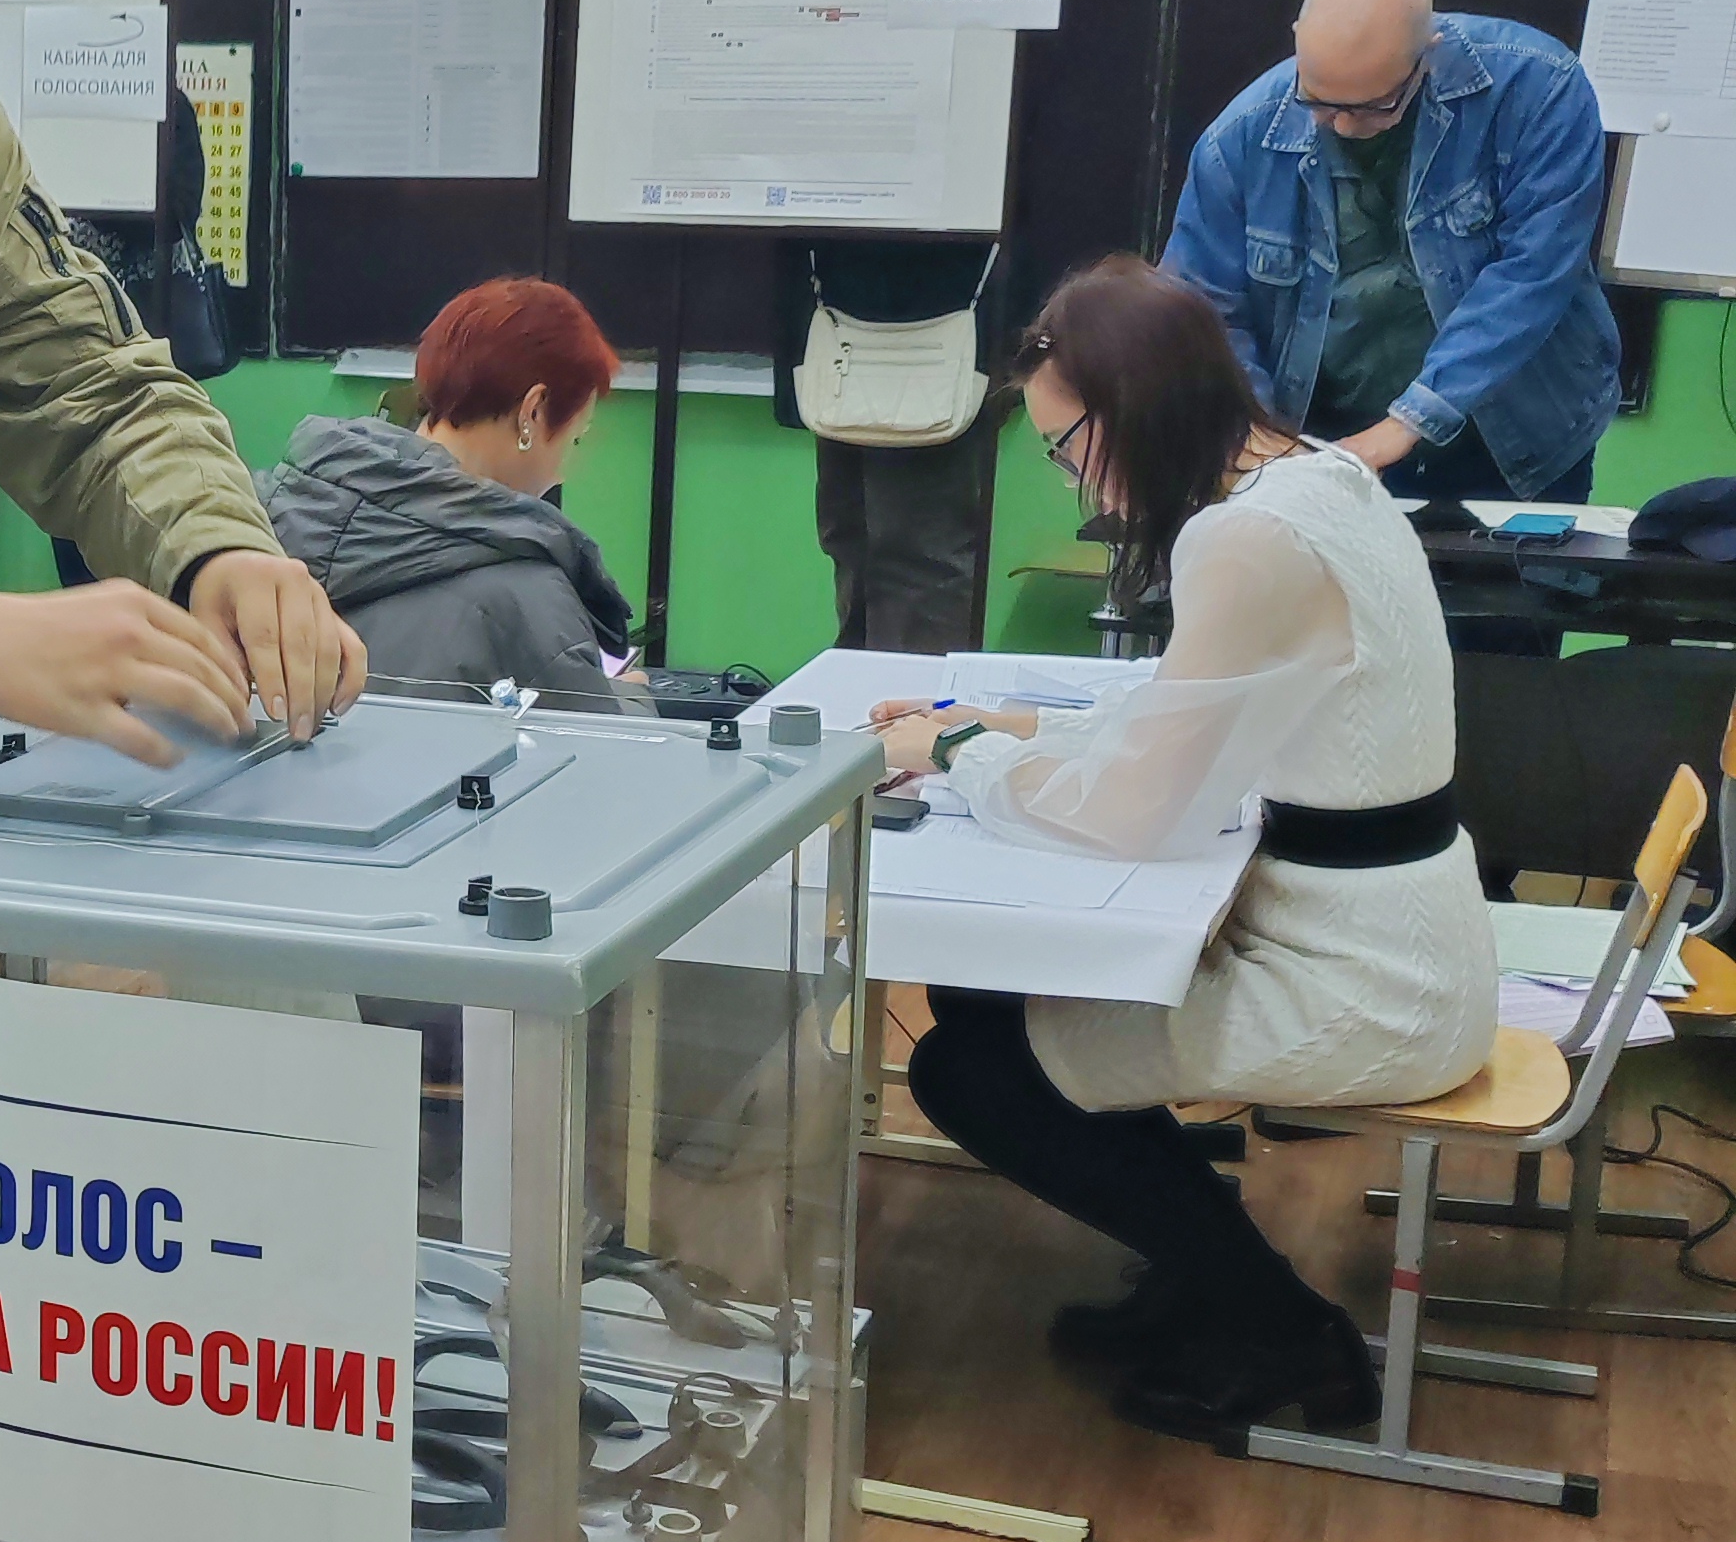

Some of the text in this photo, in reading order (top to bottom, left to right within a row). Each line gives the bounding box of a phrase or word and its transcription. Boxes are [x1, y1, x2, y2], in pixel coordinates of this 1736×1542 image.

[44, 49, 146, 69] КАБИНА ДЛЯ
[182, 59, 209, 75] ЦА
[34, 79, 154, 95] ГОЛОСОВАНИЯ
[39, 1300, 395, 1443] РОССИИ!
